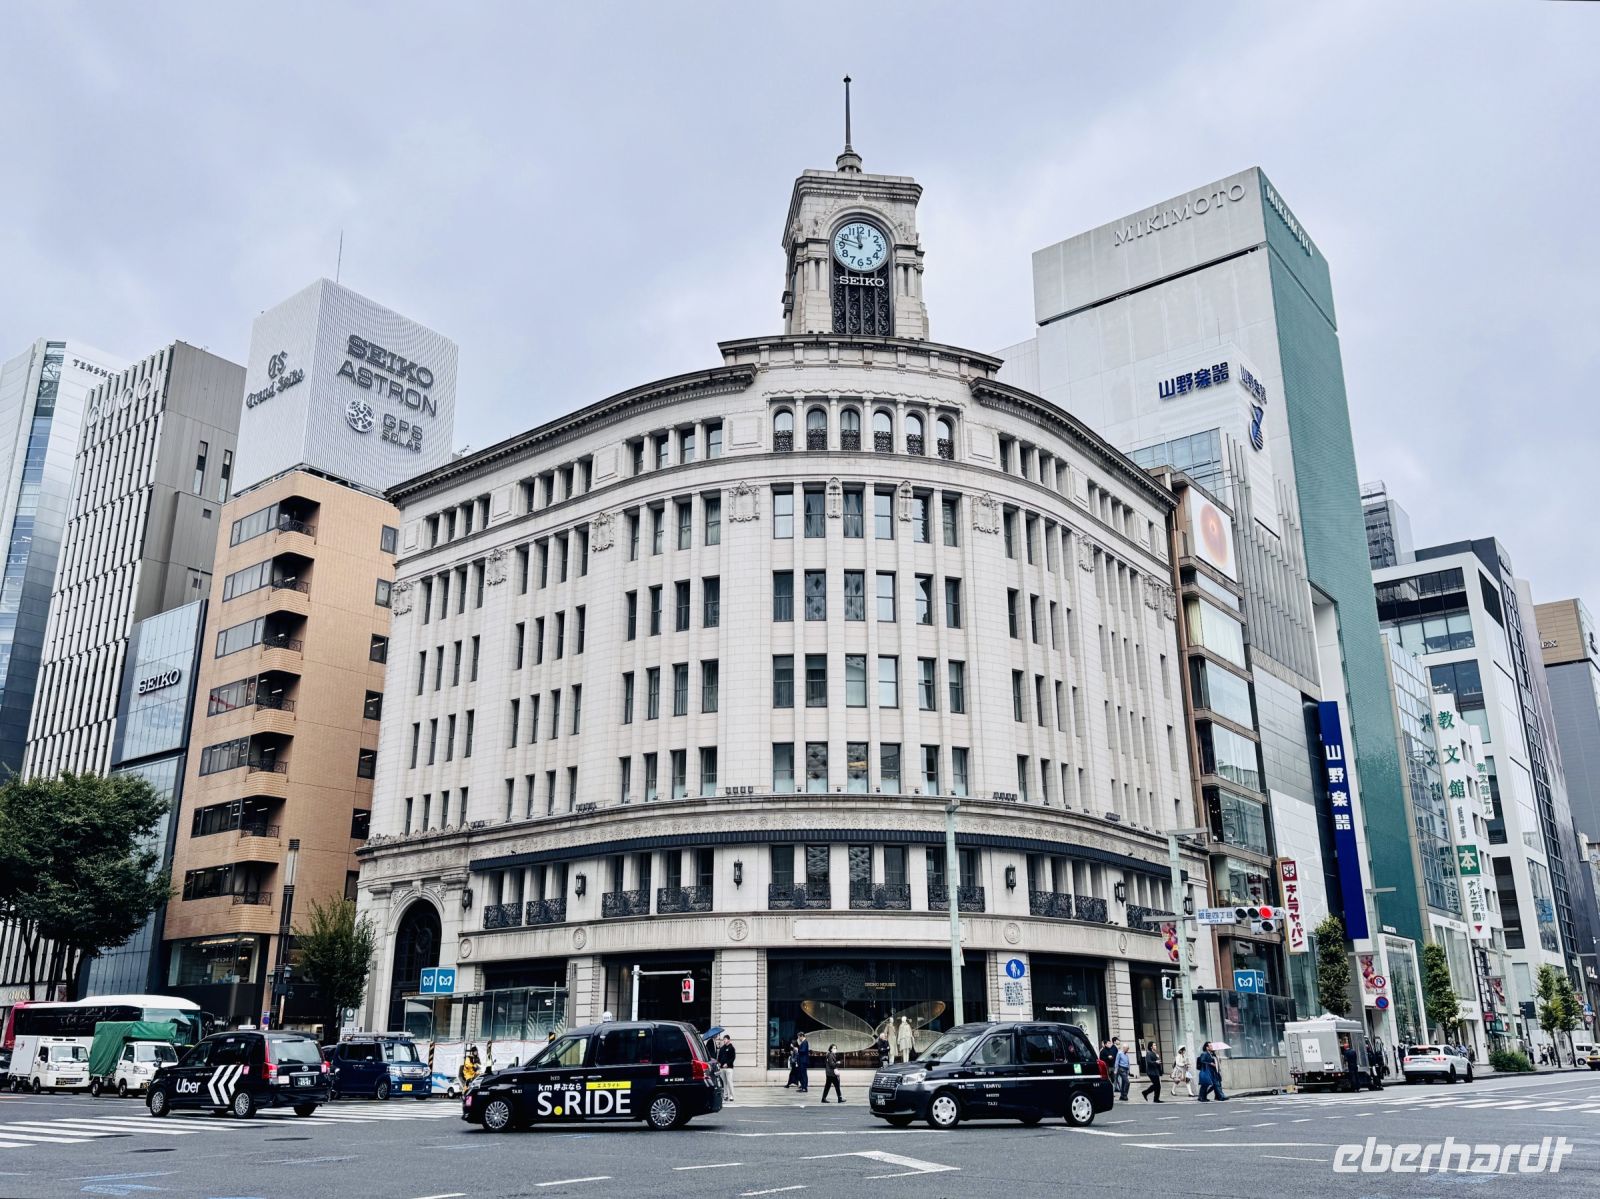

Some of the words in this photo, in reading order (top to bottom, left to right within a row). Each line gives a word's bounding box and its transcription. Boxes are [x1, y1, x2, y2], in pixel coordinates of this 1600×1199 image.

[1114, 185, 1245, 247] MIKIMOTO
[1264, 185, 1313, 257] MIKIMOTO
[838, 241, 846, 250] 9
[849, 228, 855, 236] 11
[872, 235, 880, 244] 2
[842, 249, 849, 258] 8
[849, 255, 856, 264] 7
[872, 251, 880, 260] 4
[875, 243, 882, 252] 3
[857, 258, 864, 267] 6
[866, 257, 873, 266] 5
[839, 275, 885, 287] SEIKO
[268, 350, 288, 379] GS
[346, 334, 434, 389] SEIKO
[246, 381, 277, 409] Grand
[276, 368, 306, 393] Seiko
[336, 360, 437, 418] ASTRON
[1158, 361, 1230, 399] 山野楽器
[381, 424, 422, 453] SOLAR
[383, 413, 423, 441] GPS
[137, 668, 181, 695] SEIKO
[1437, 710, 1466, 799] 教文館
[1325, 744, 1351, 830] 山野楽器
[1476, 762, 1493, 815] 教文館ビル
[1458, 849, 1478, 871] 本
[1198, 911, 1233, 919] 銀座四丁目
[1285, 883, 1304, 948] キムラヤのパン
[176, 1078, 201, 1094] Uber
[537, 1090, 632, 1117] S.RIDE
